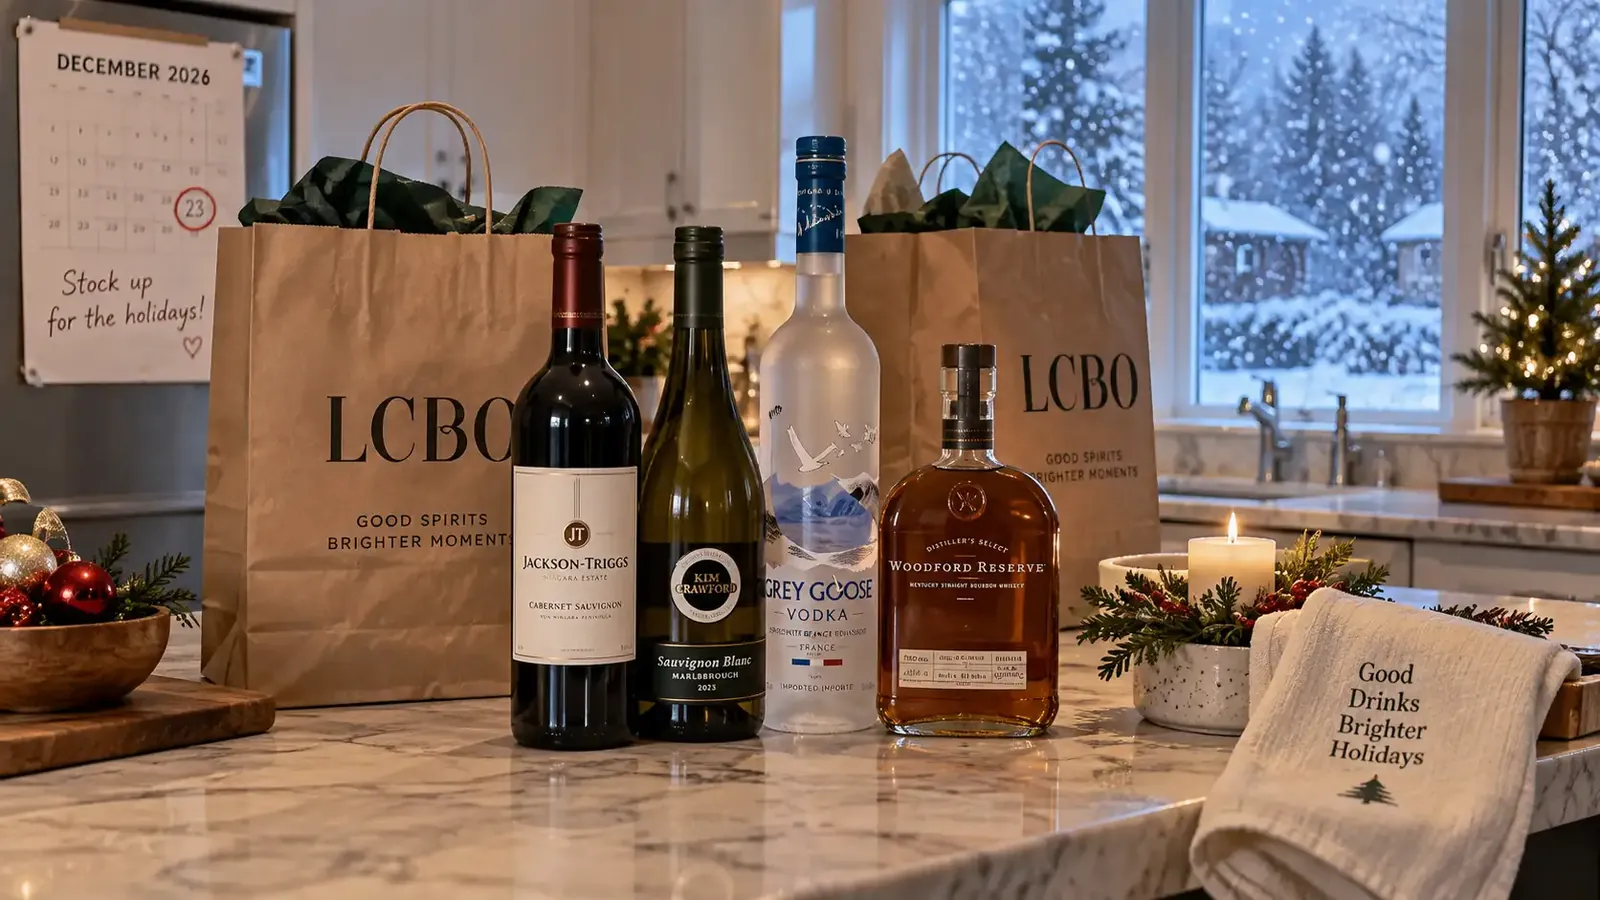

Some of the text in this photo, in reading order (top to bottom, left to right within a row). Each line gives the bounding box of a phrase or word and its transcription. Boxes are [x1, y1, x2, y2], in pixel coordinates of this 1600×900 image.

[57, 53, 211, 86] DECEMBER 2026
[185, 199, 204, 218] 23
[61, 269, 153, 299] Stock up
[47, 295, 205, 337] for the holidays!
[1020, 352, 1138, 413] LCBO
[326, 395, 515, 463] LCBO
[1046, 450, 1123, 465] GOOD SPIRITS
[1089, 466, 1138, 480] MOMENTS
[356, 513, 488, 528] GOOD SPIRITS
[328, 535, 421, 550] BRIGHTER
[568, 527, 585, 542] JT
[925, 537, 1009, 554] DISTILLER'S SELECT
[523, 555, 629, 570] JACKSON-TRIGGS
[889, 560, 1045, 573] WOODFORD RESERVE
[581, 574, 608, 582] ESTATE
[694, 573, 720, 583] KIM
[675, 582, 738, 594] CRAWFORD
[765, 578, 873, 601] GREY GOOSE
[529, 600, 623, 611] CABERNET SAUVIGNON
[787, 607, 848, 621] VODKA
[799, 643, 836, 652] FRANCE
[657, 654, 752, 671] Sauvignon Blanc
[1359, 661, 1414, 684] Good
[1348, 687, 1420, 713] Drinks
[1337, 713, 1427, 743] Brighter
[1329, 739, 1424, 769] Holidays
